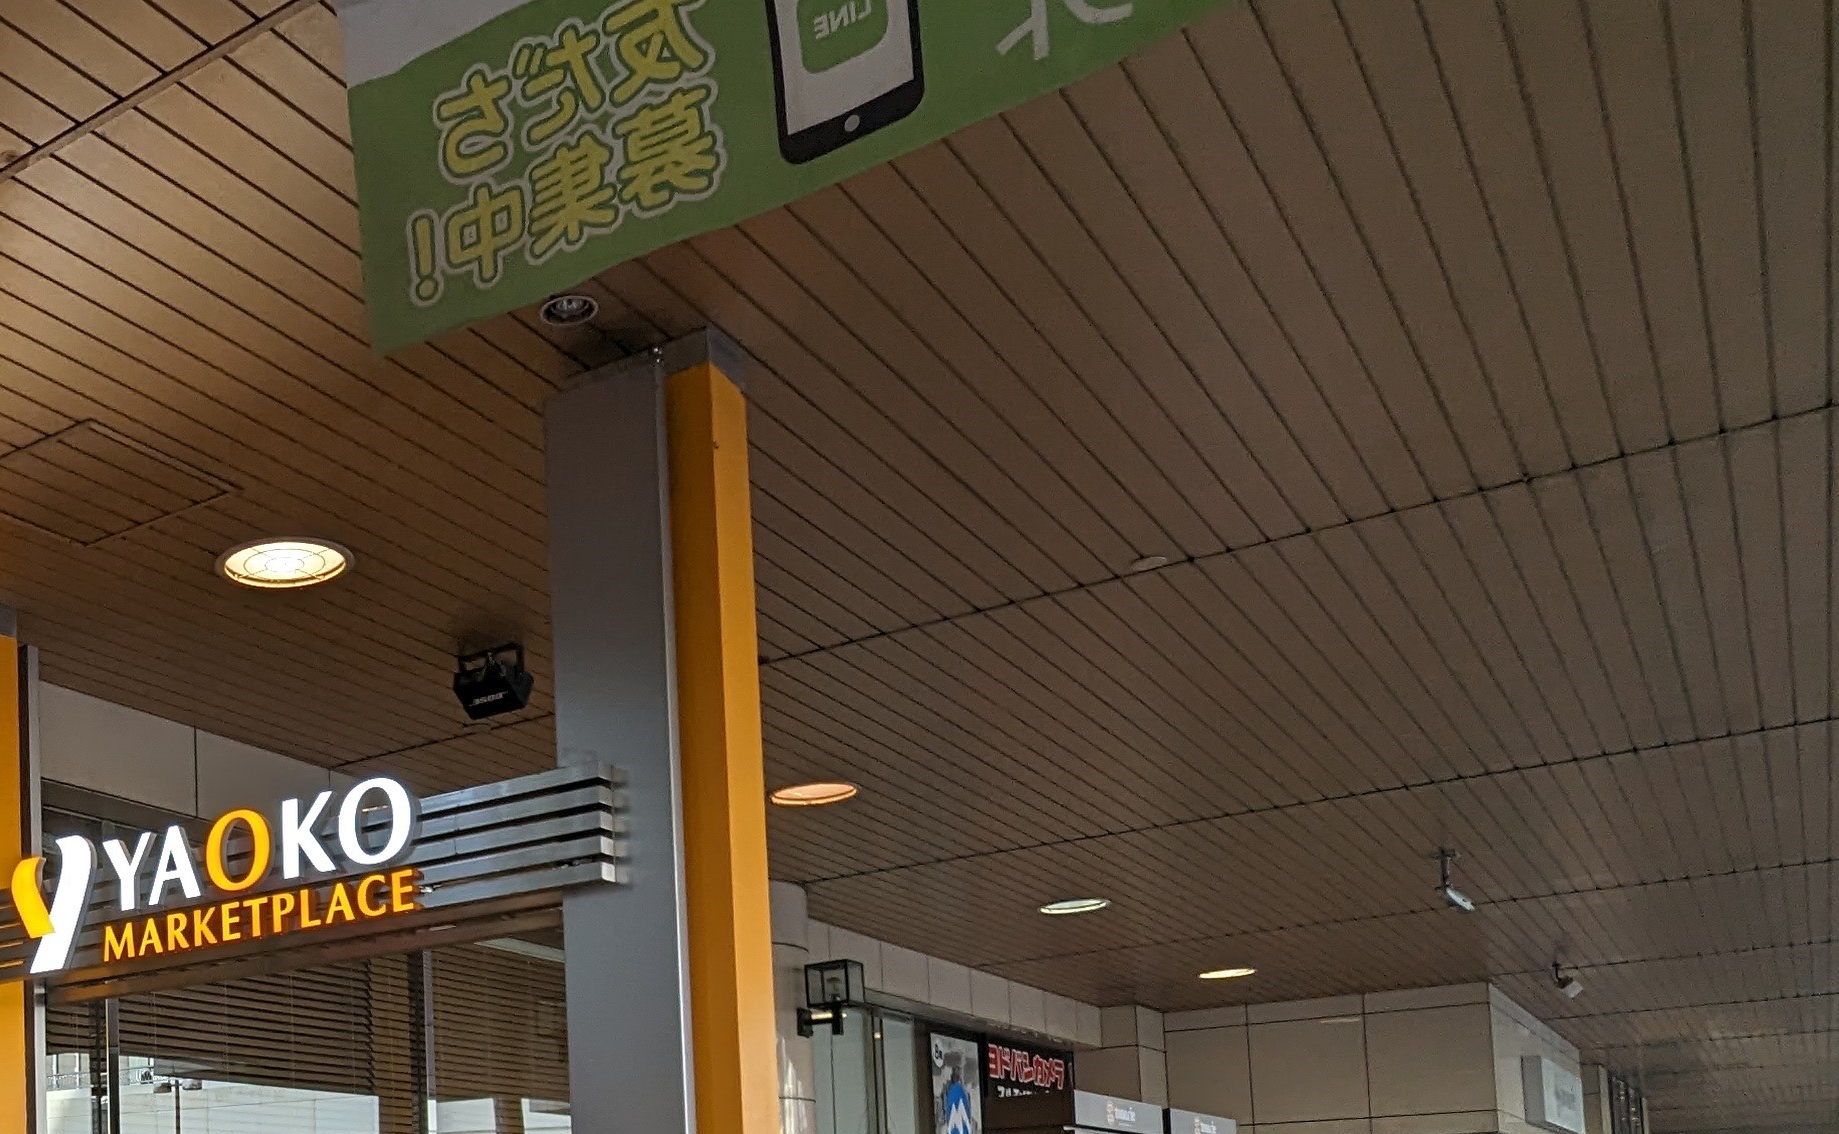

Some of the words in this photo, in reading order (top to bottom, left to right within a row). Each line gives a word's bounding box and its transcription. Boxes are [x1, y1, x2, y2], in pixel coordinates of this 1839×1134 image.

[103, 777, 412, 912] YAOKO
[103, 869, 418, 962] MARKETPLACE
[988, 1043, 1064, 1090] ヨドバシカメラ
